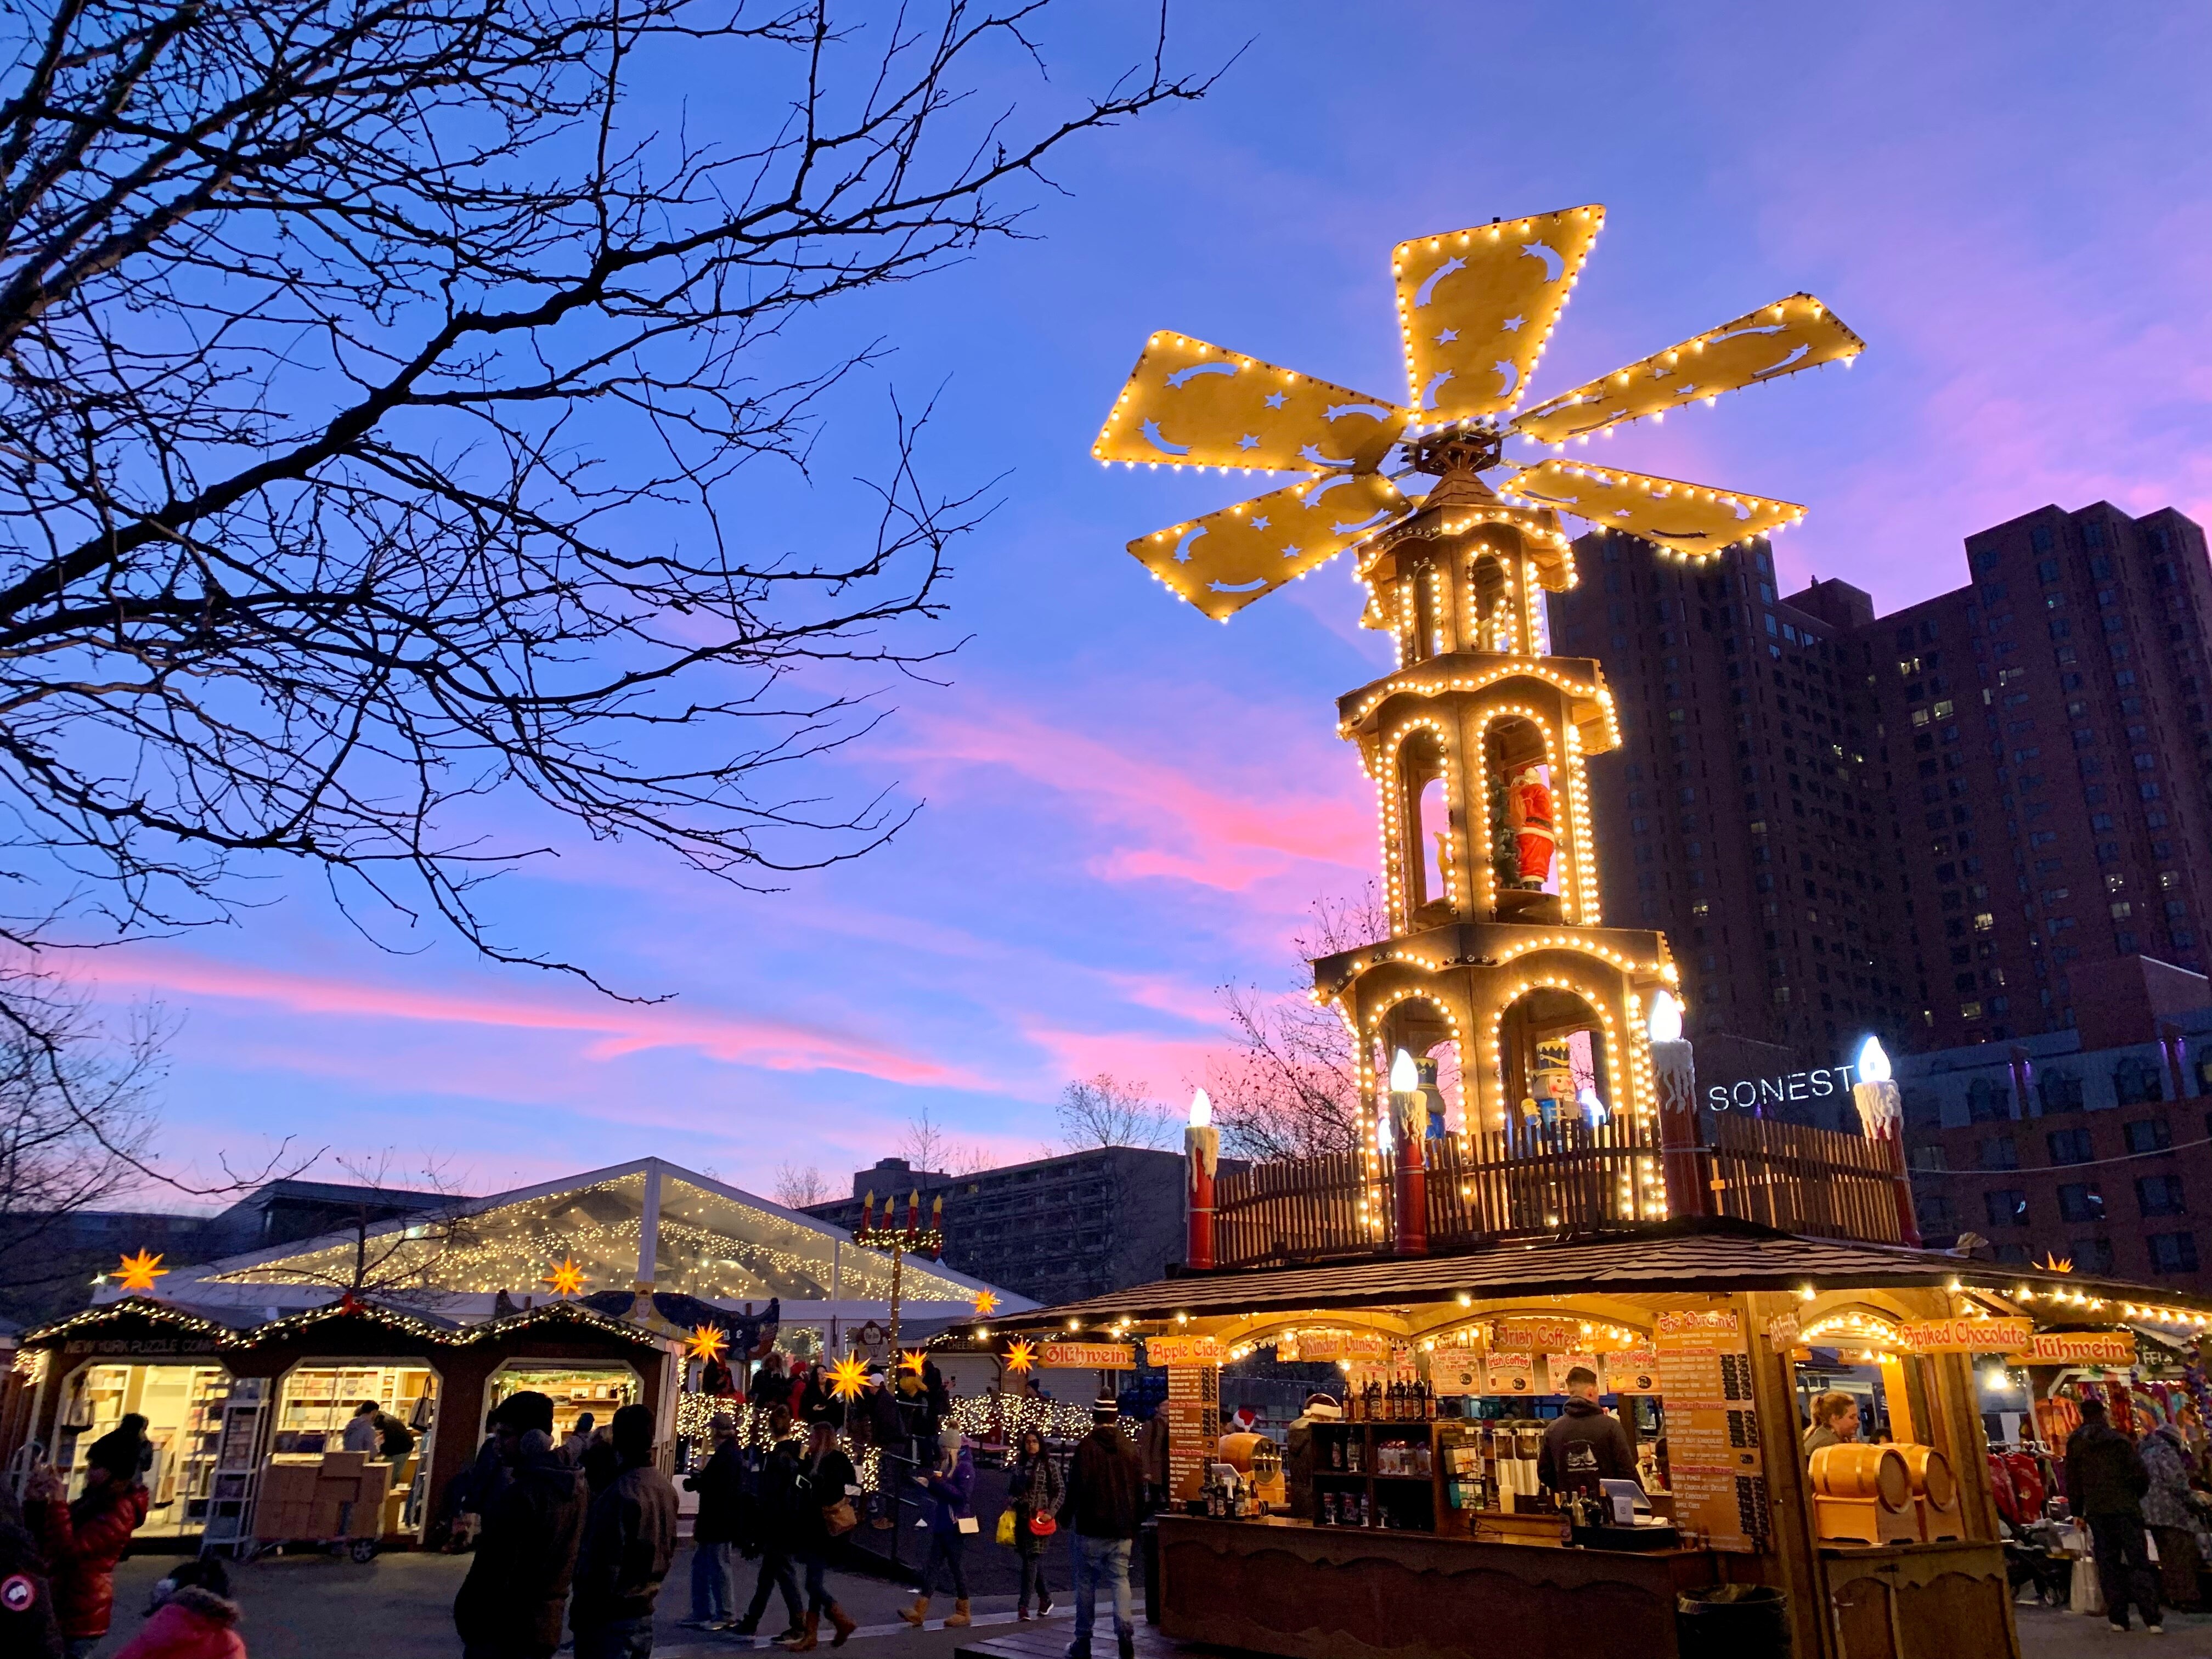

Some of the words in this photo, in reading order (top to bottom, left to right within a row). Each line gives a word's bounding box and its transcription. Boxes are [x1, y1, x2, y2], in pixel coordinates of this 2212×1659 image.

[1709, 1065, 1854, 1111] SONEST
[1659, 1316, 1681, 1334] The
[1683, 1311, 1738, 1331] Pyramid
[1305, 1338, 1339, 1356] Kinder
[1345, 1334, 1383, 1358] Punsch
[1497, 1325, 1534, 1350] Irish
[1537, 1325, 1577, 1347] Coffee
[1901, 1321, 1951, 1351] Spiked
[1955, 1321, 2027, 1350] Chocolate
[1045, 1345, 1128, 1365] Glühwein
[1153, 1341, 1188, 1363] Apple
[1192, 1340, 1227, 1358] Cider
[1549, 1356, 1561, 1365] Hot
[1609, 1352, 1624, 1364] Hot
[1625, 1352, 1653, 1365] Toddy
[2020, 1335, 2127, 1363] lühwein
[1487, 1356, 1504, 1368] Irish
[1504, 1355, 1531, 1369] Coffee
